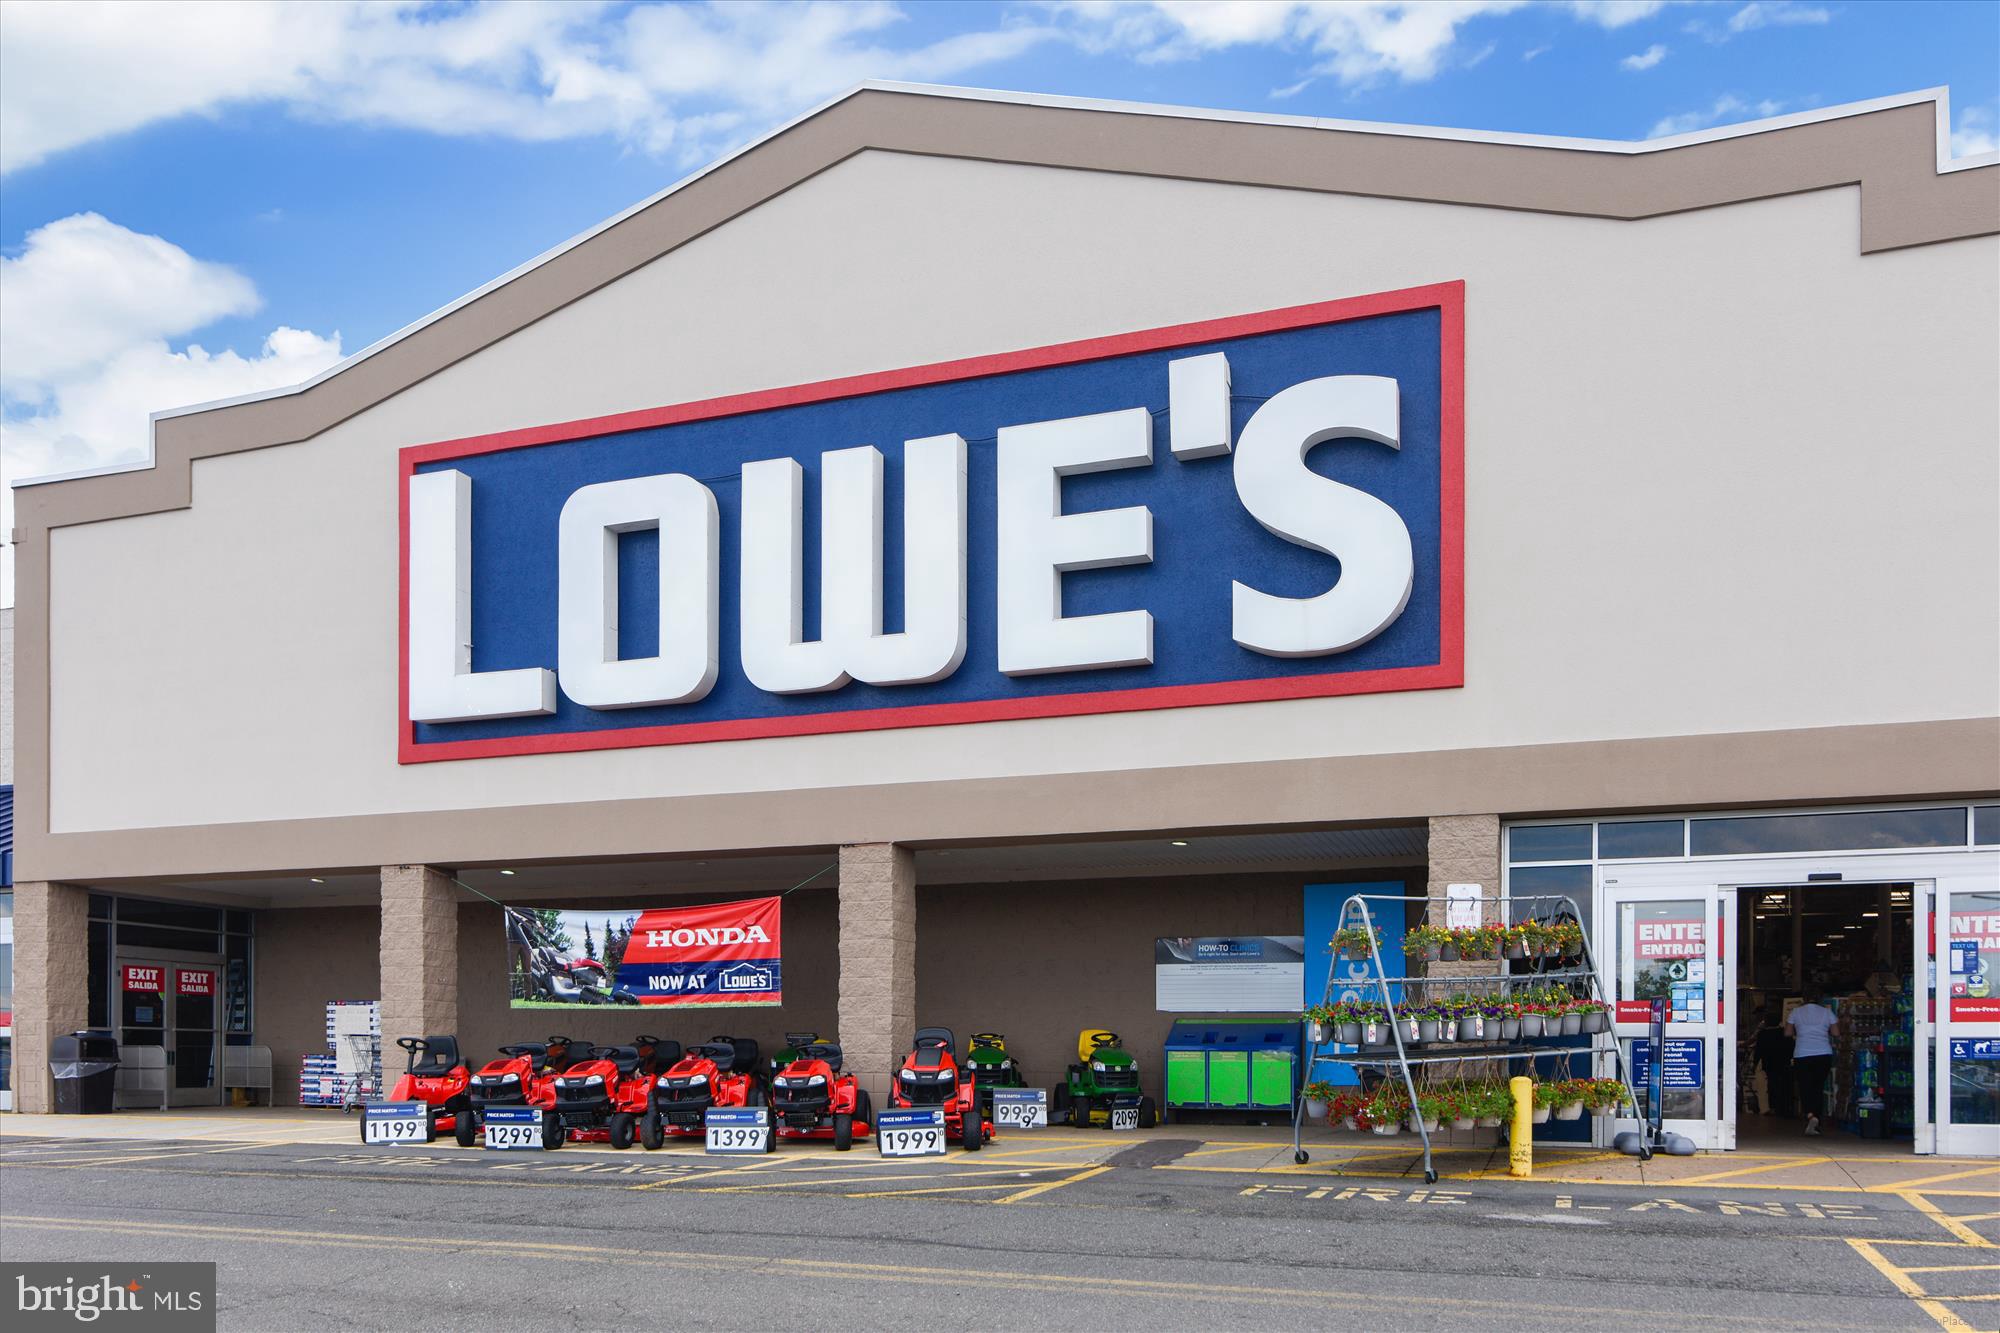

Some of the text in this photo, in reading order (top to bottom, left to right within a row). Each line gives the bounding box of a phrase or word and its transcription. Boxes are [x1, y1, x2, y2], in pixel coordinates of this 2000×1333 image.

[409, 352, 1414, 723] LOWE'S
[1640, 923, 1704, 941] ENTE
[1950, 915, 2000, 934] NTE
[646, 925, 771, 948] HONDA
[1198, 944, 1229, 952] HOW-TO
[1641, 944, 1705, 956] ENTRAD
[128, 968, 158, 981] EXIT
[181, 972, 208, 984] EXIT
[724, 973, 768, 988] LOWE'S
[128, 981, 159, 990] SALIDA
[181, 984, 209, 993] SALIDA
[648, 975, 707, 990] NOW AT
[1239, 1184, 1878, 1221] FIRE LANE
